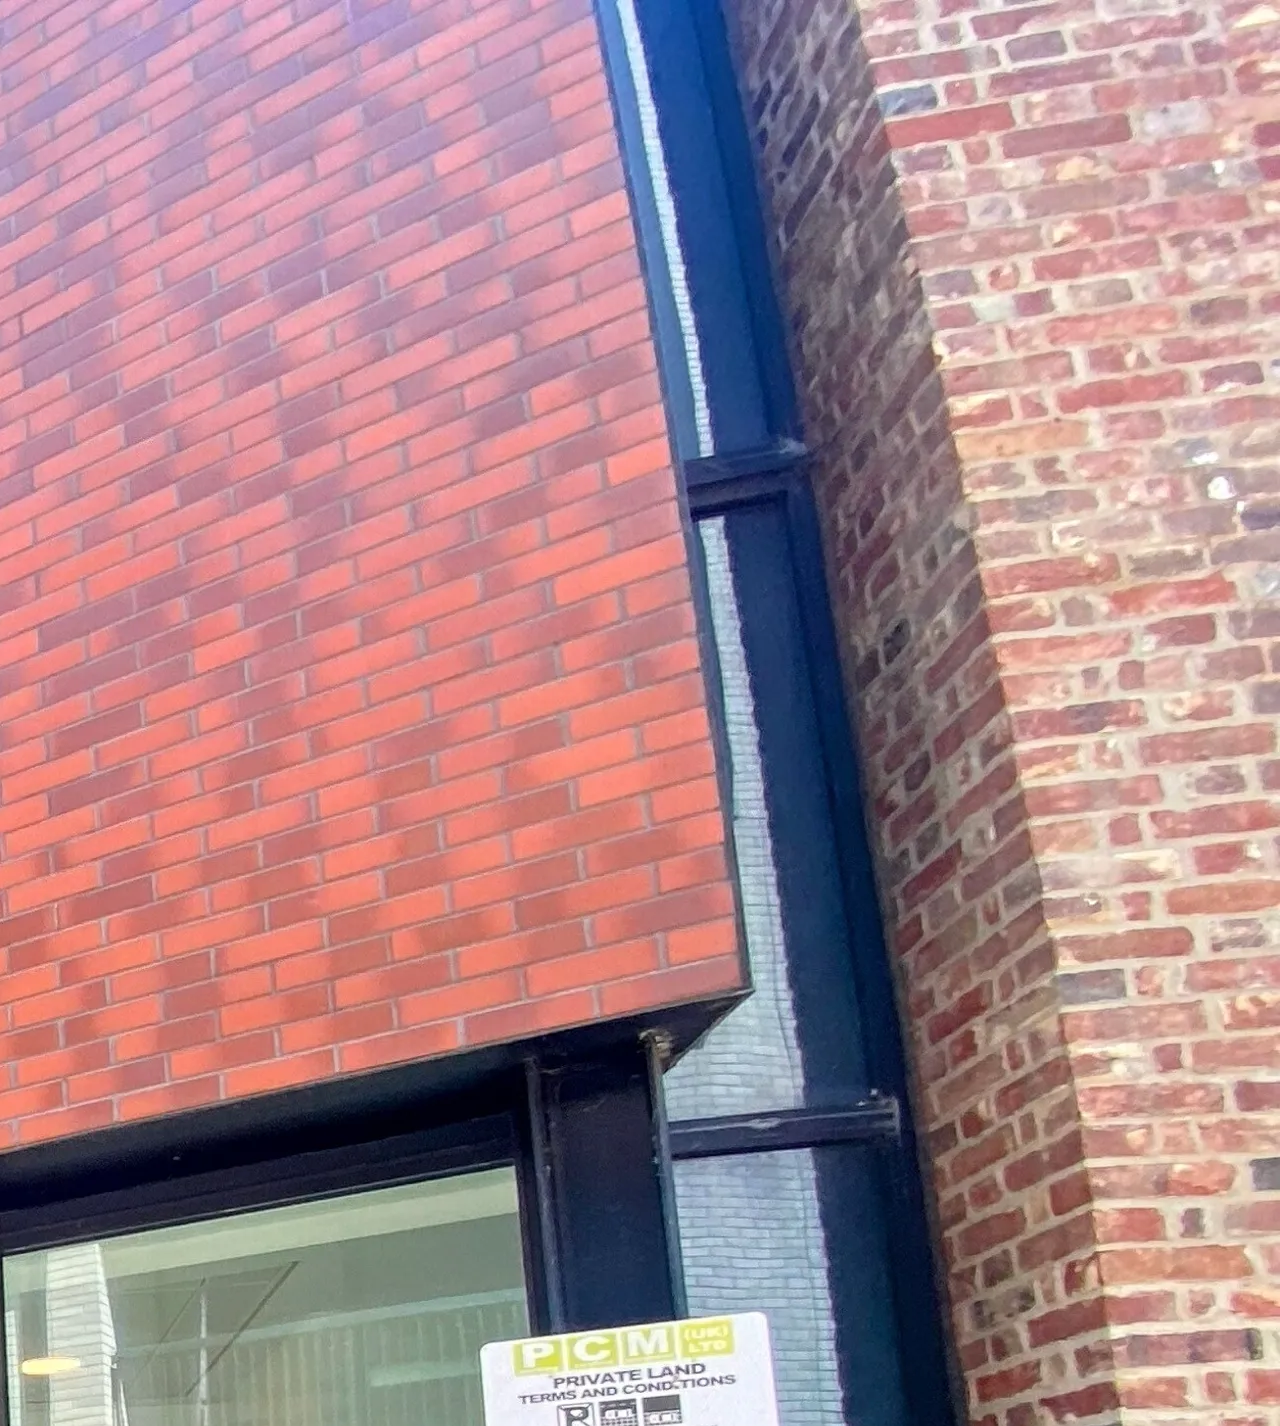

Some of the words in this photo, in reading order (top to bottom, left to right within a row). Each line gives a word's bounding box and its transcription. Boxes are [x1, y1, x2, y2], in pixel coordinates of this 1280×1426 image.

[553, 1369, 642, 1389] PRIVATE
[647, 1363, 706, 1379] LAND
[518, 1390, 576, 1404] TERMS
[581, 1386, 618, 1398] AND
